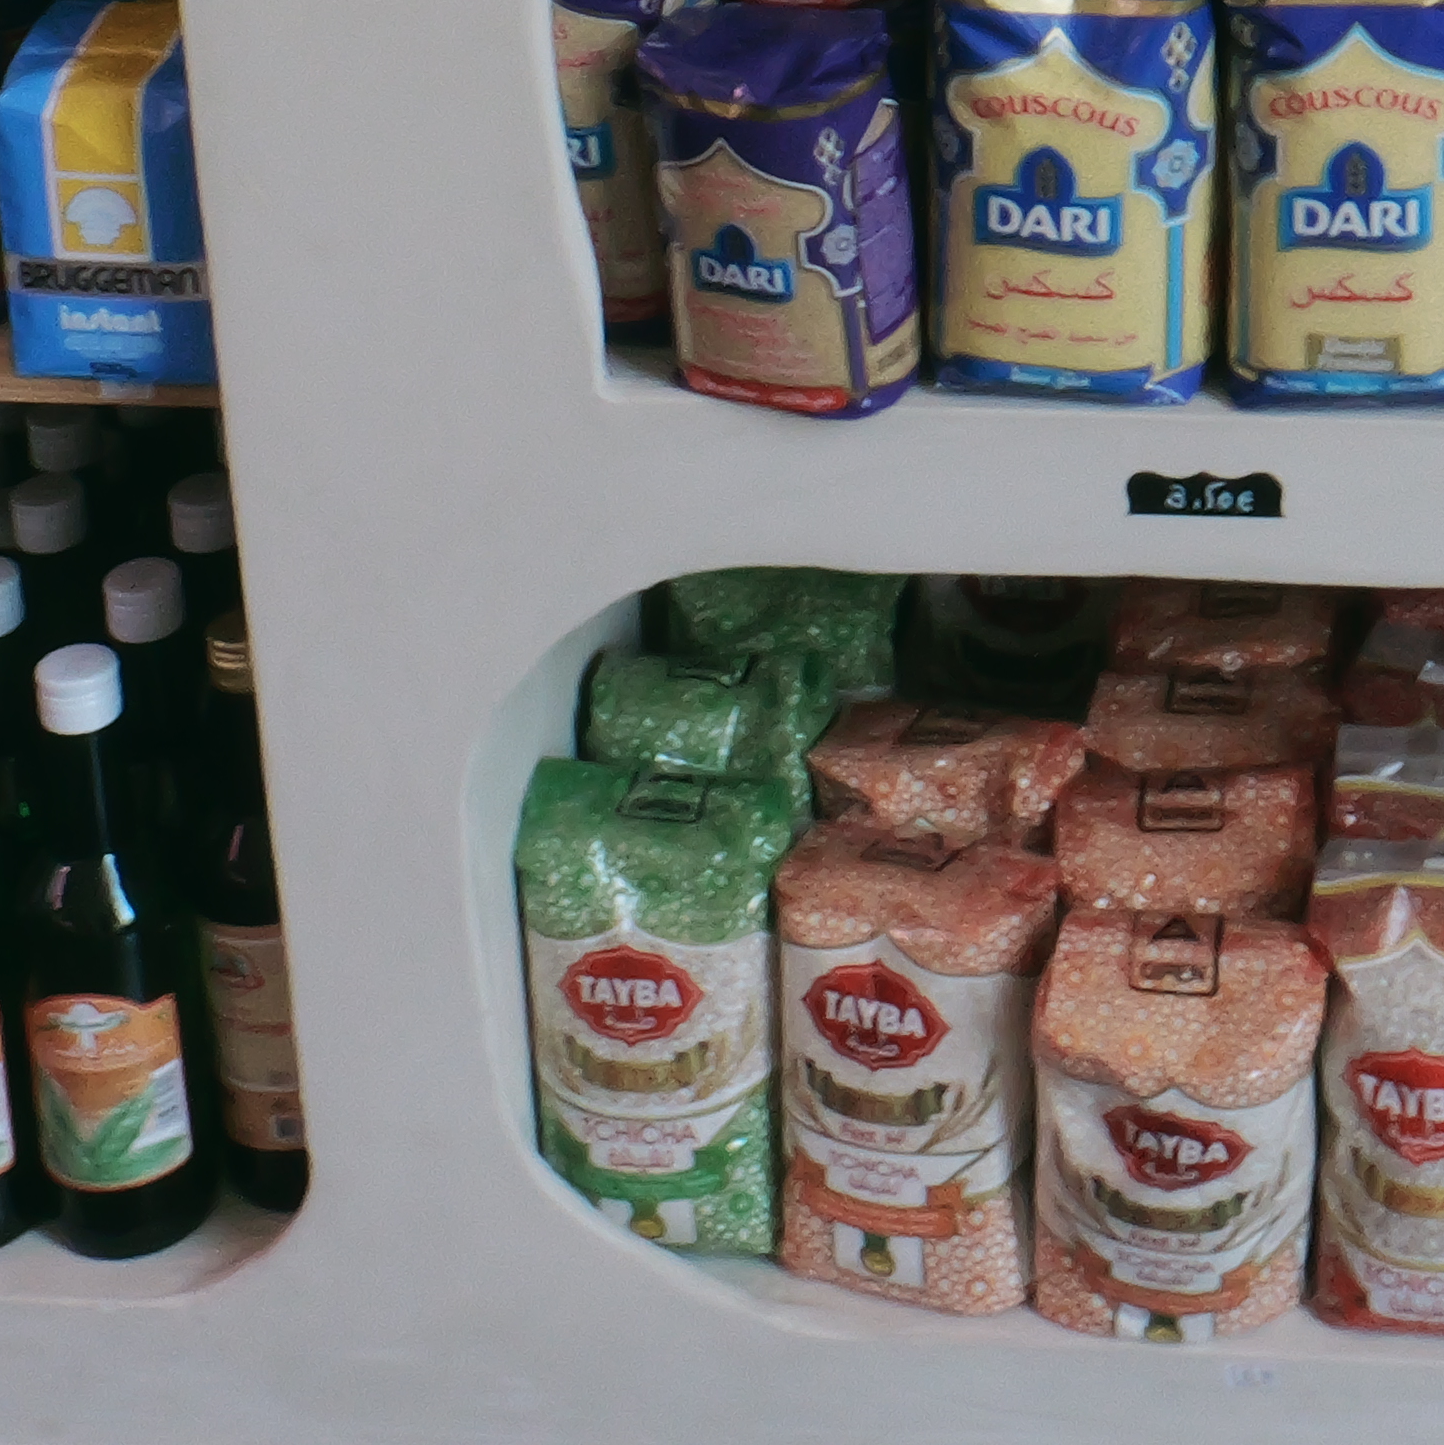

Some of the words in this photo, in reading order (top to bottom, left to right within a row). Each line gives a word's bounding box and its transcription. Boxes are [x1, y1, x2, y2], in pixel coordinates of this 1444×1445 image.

[970, 94, 1140, 138] COUSCOUS
[1269, 84, 1443, 123] COUSCOUS
[986, 195, 1112, 244] DARI
[1291, 196, 1421, 241] DARI
[697, 256, 786, 293] DARI
[577, 976, 683, 1011] TAYBA
[823, 990, 927, 1039] TAYBA
[1125, 1124, 1232, 1168] TAYBA
